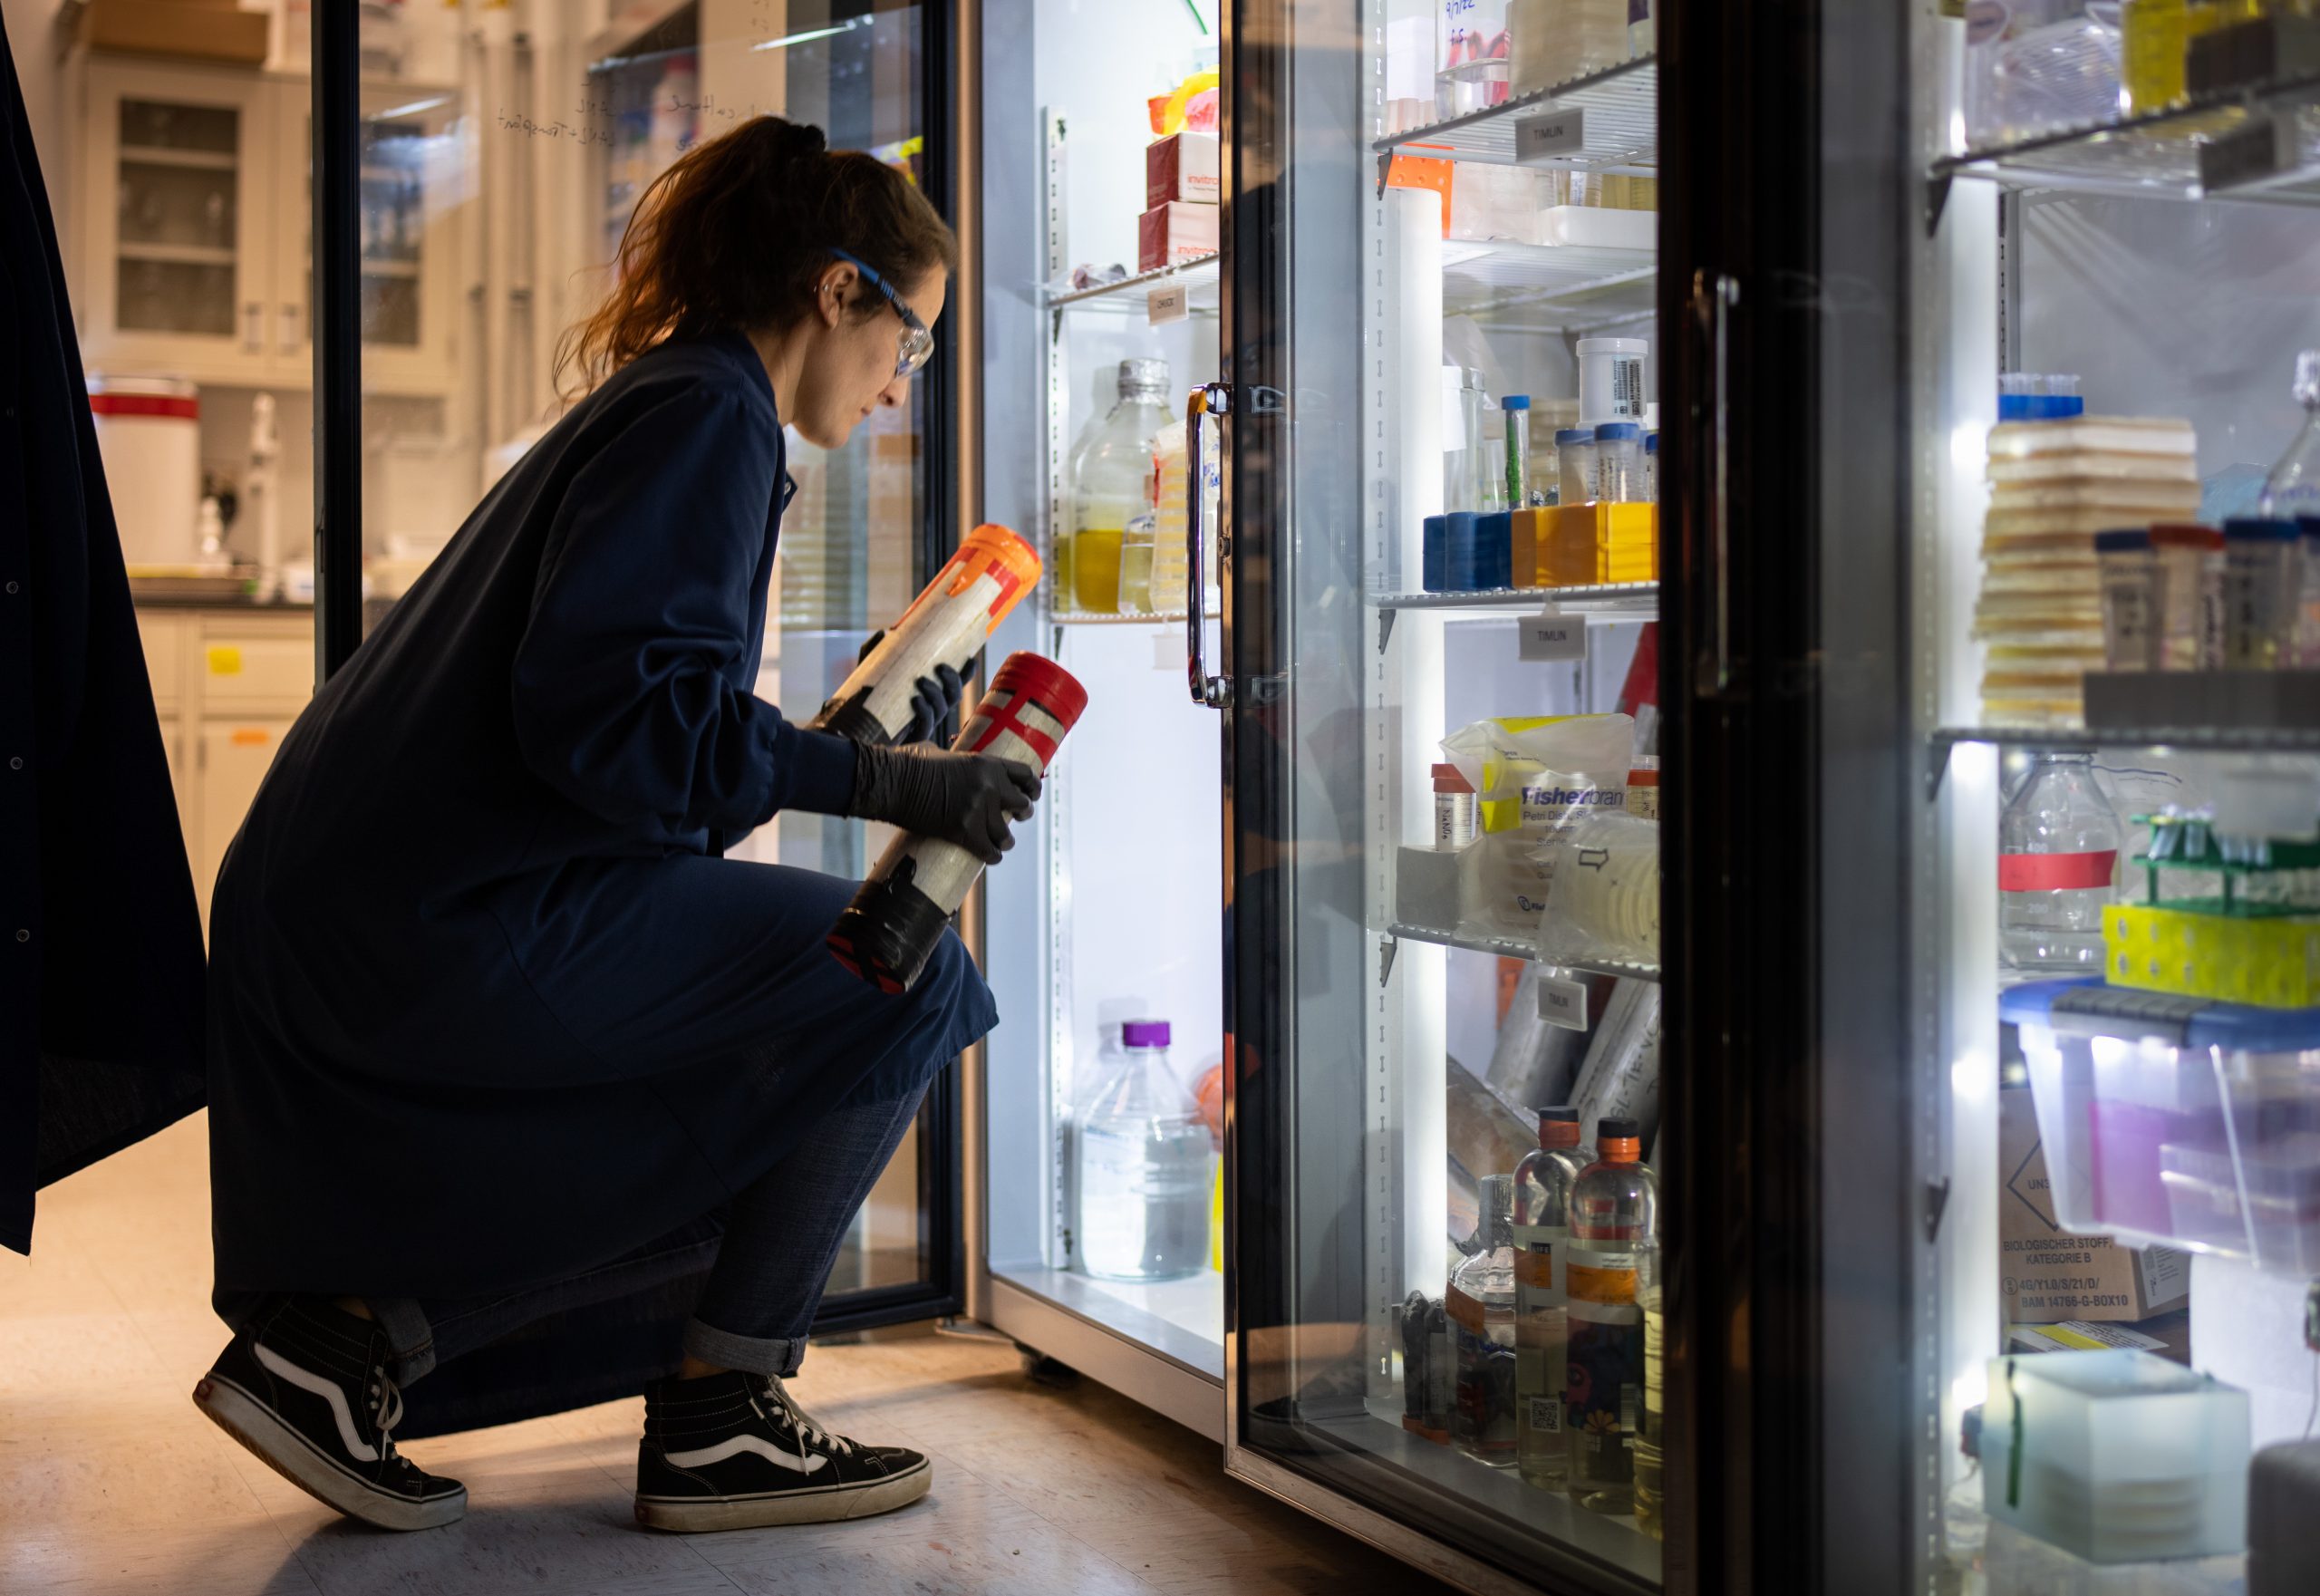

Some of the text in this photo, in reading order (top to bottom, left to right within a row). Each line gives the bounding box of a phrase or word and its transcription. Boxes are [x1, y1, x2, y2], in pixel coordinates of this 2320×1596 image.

[2003, 1237, 2112, 1252] BIOLOGISCHER STOFF,
[2025, 1252, 2092, 1264] KATEGORIE B
[2022, 1297, 2044, 1308] BAM
